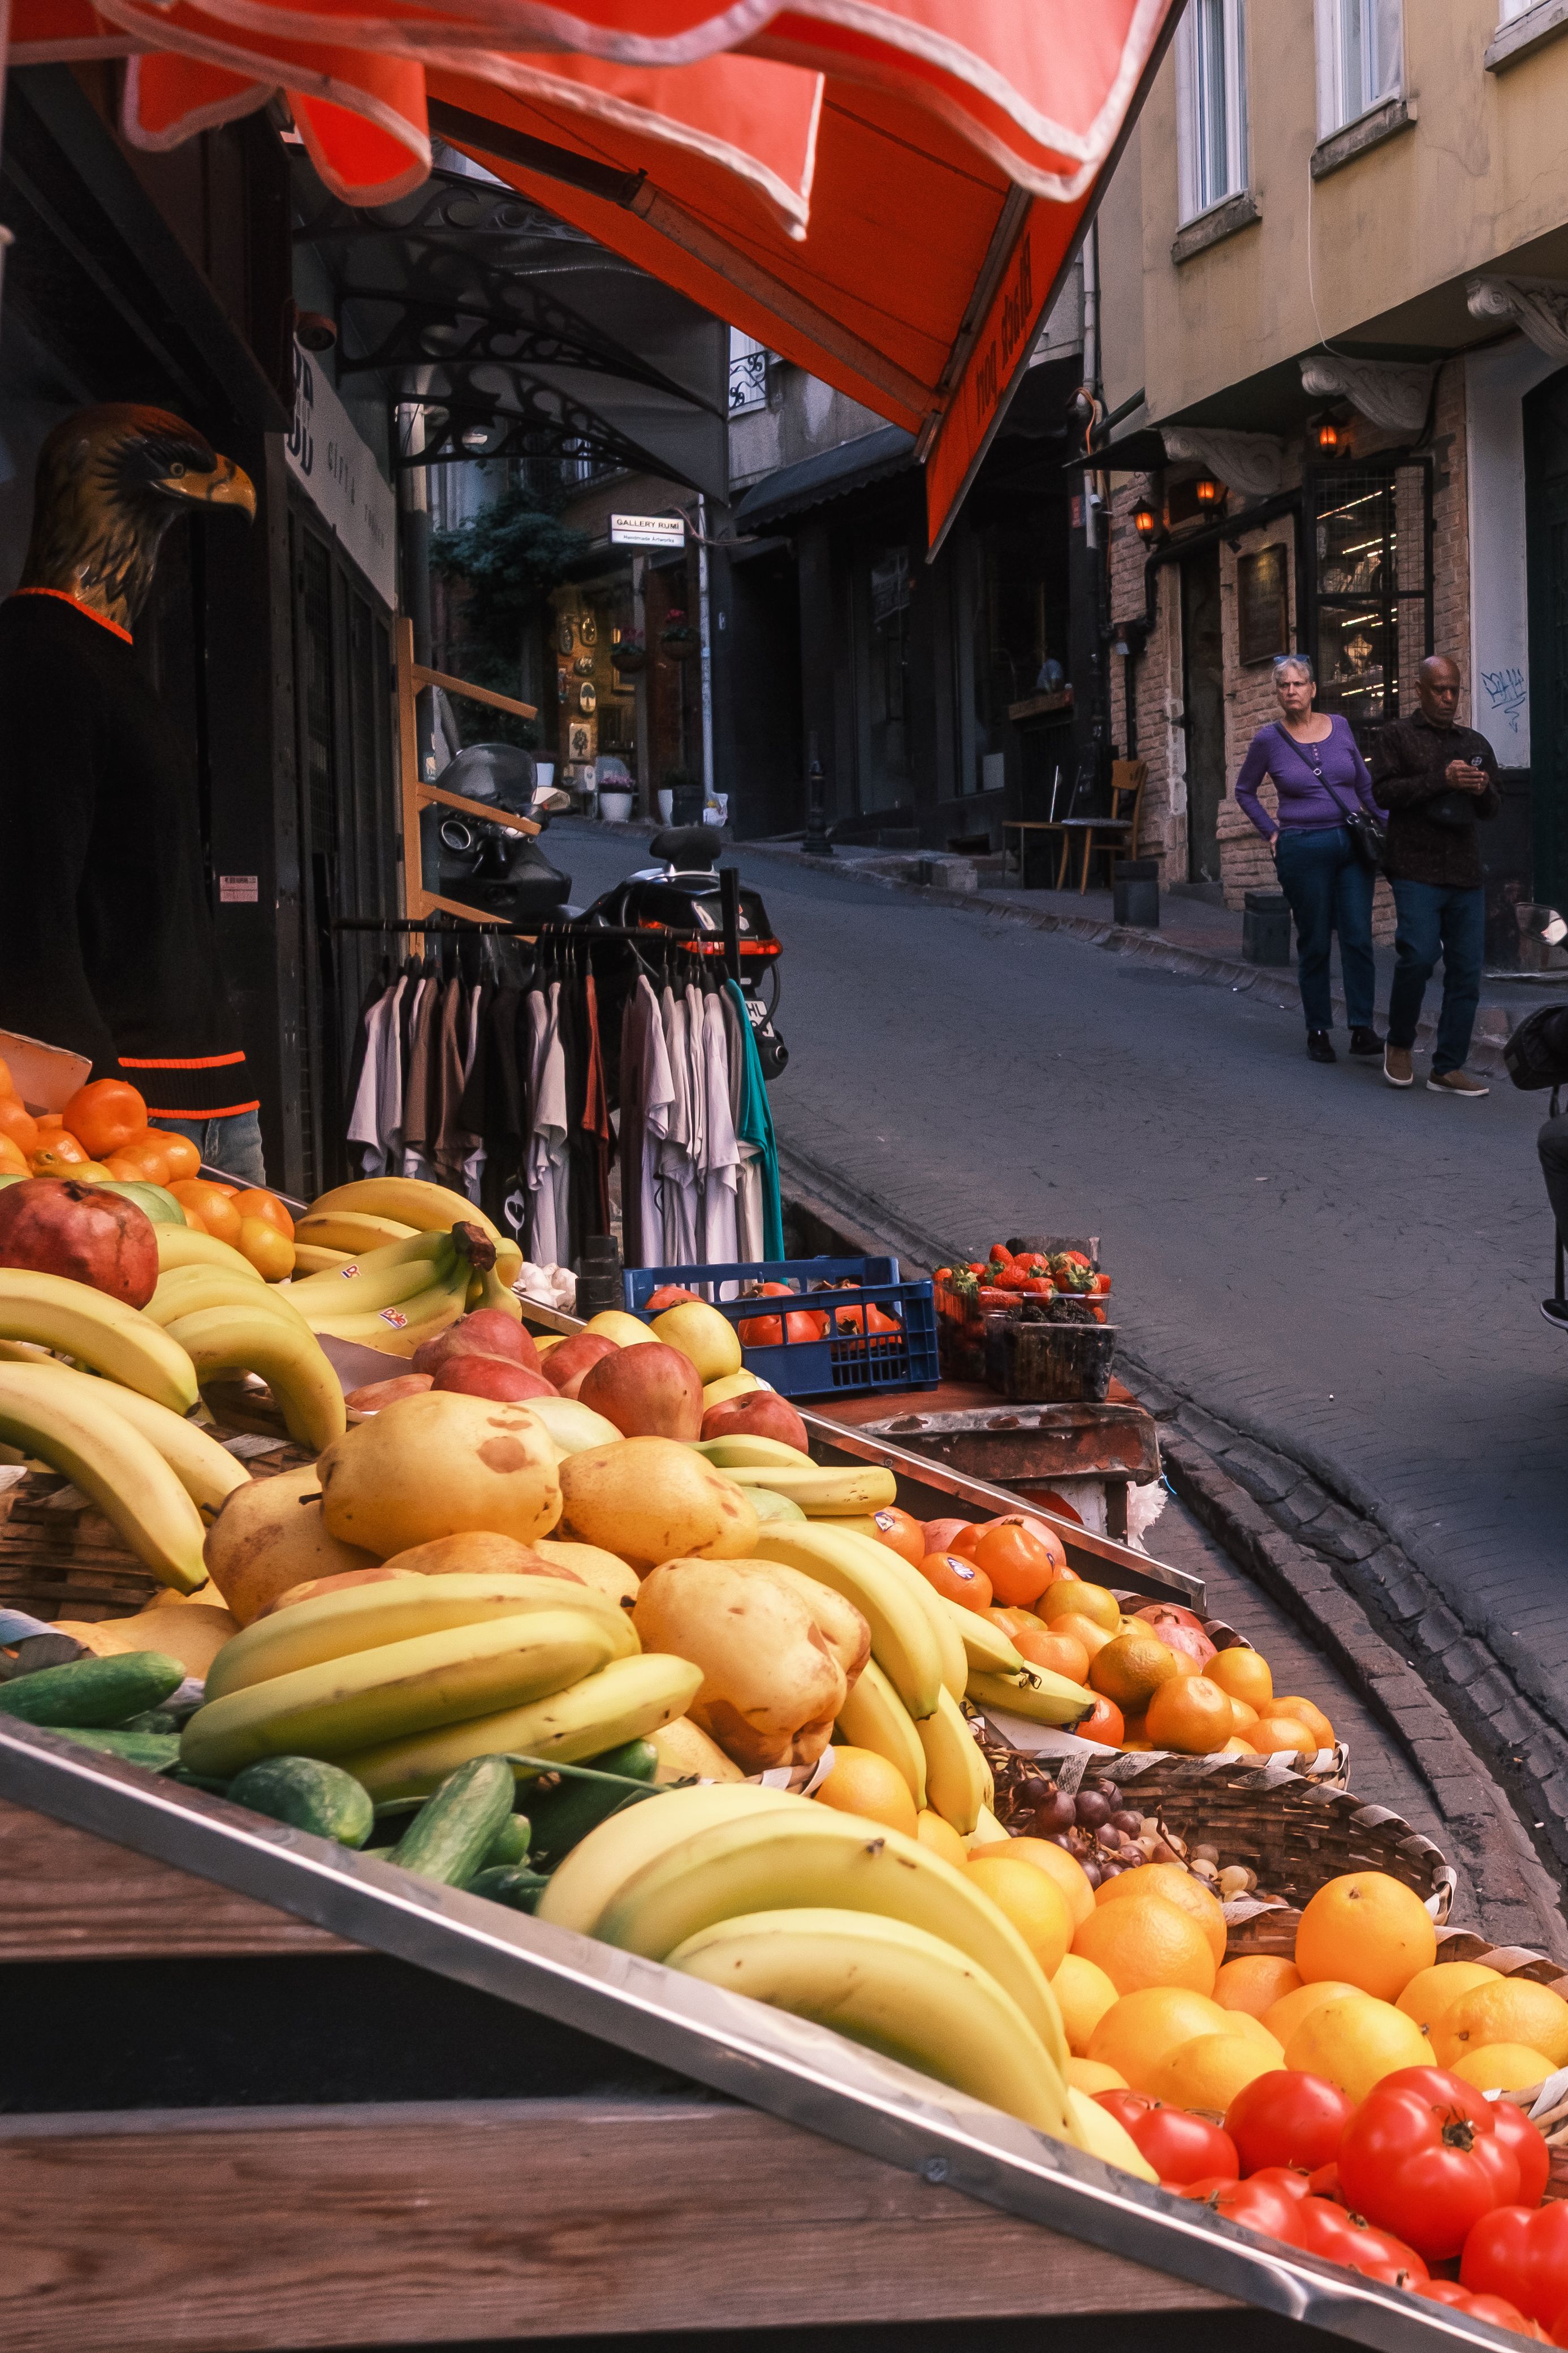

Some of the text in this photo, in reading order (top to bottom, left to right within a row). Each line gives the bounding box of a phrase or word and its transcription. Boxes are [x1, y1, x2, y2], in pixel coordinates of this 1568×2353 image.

[616, 519, 655, 528] GALLERY
[345, 1265, 361, 1278] Do
[383, 1308, 407, 1326] Dole
